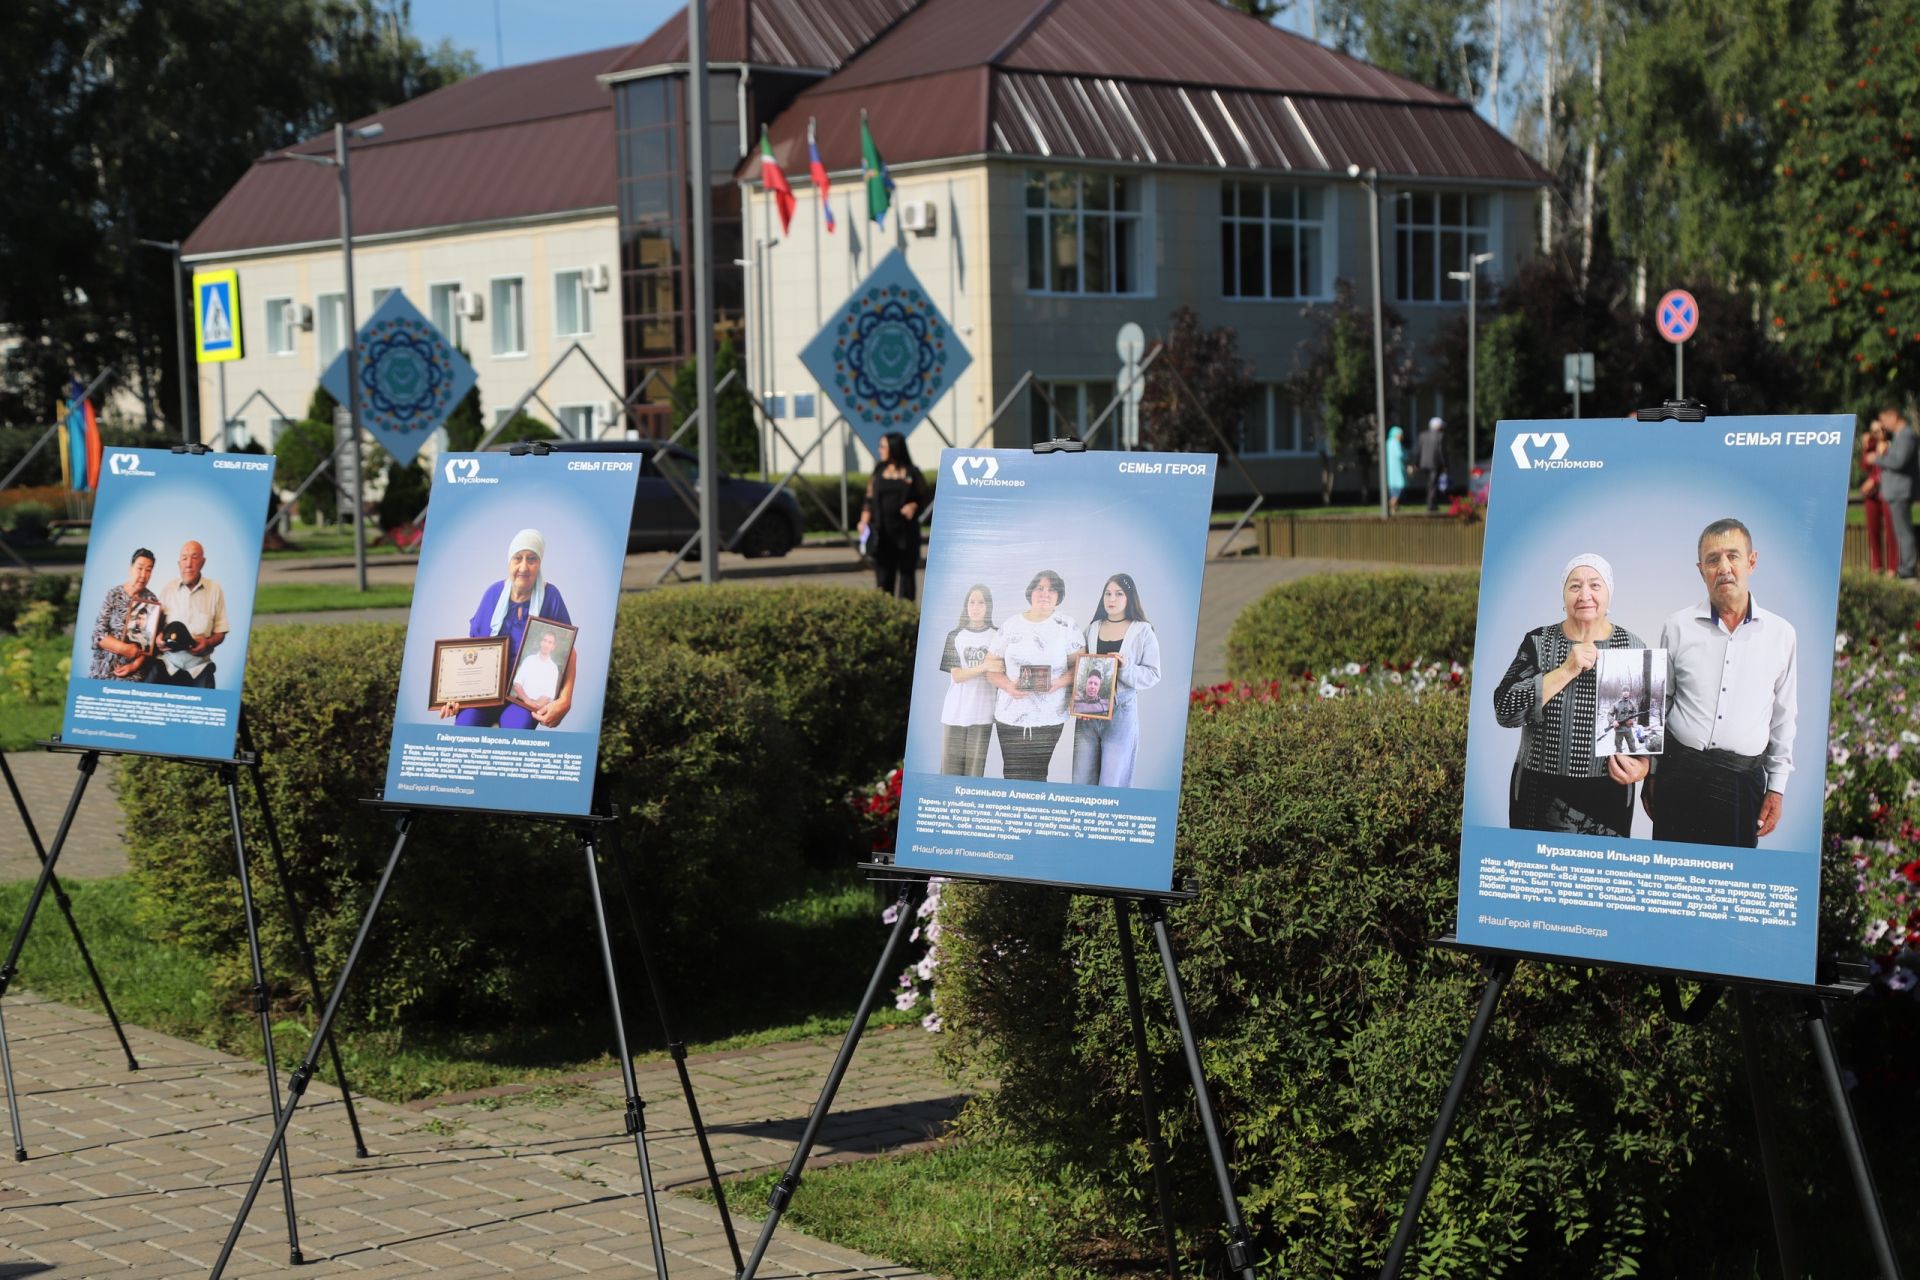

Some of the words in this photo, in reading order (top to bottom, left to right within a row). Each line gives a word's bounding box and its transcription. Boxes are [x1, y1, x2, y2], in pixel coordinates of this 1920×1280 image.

[1724, 432, 1781, 446] СЕМЬЯ
[1786, 431, 1841, 445] ГЕРОЯ
[213, 460, 241, 470] СЕМЬЯ
[242, 461, 268, 471] ГЕРОЯ
[568, 461, 600, 471] СЕМЬЯ
[602, 462, 633, 472] ГЕРОЯ
[1119, 462, 1162, 474] СЕМЬЯ
[1165, 463, 1206, 475] ГЕРОЯ
[1534, 458, 1604, 471] Муслюмово
[457, 476, 499, 485] Муслюмово
[970, 477, 1025, 488] Муслюмово
[481, 736, 511, 745] Марсель
[511, 738, 550, 747] Алмазович
[955, 786, 1007, 798] Красиньков
[1009, 790, 1046, 801] Алексей
[1048, 793, 1119, 806] Александрович
[912, 845, 954, 856] #НашГерой
[955, 849, 1014, 861] #ПомнимВсегда
[1537, 844, 1604, 859] Мурзаханов
[1607, 850, 1650, 866] Ильнар
[1653, 854, 1734, 871] Мирзаянович
[1480, 866, 1507, 876] любие,
[1521, 870, 1556, 880] говорил:
[1558, 873, 1578, 881] «Всё
[1580, 875, 1611, 884] сделаю
[1613, 878, 1637, 886] сам».
[1638, 879, 1663, 889] Часто
[1664, 883, 1713, 894] выбирался
[1727, 889, 1767, 900] природу,
[1769, 893, 1798, 901] чтобы
[1481, 858, 1501, 866] «Наш
[1503, 860, 1549, 870] «Мурзахан»
[1551, 864, 1568, 872] был
[1570, 867, 1595, 875] тихим
[1605, 870, 1652, 880] спокойным
[1654, 874, 1687, 883] парнем.
[1690, 876, 1706, 884] Все
[1708, 879, 1750, 888] отмечали
[1752, 882, 1767, 890] его
[1769, 884, 1798, 893] трудо-
[1479, 881, 1506, 890] Любил
[1510, 885, 1553, 895] проводить
[1558, 889, 1584, 898] время
[1598, 892, 1636, 903] большой
[1641, 897, 1683, 907] компании
[1687, 902, 1718, 911] друзей
[1734, 905, 1772, 916] близких.
[1480, 874, 1529, 885] порыбачить.
[1531, 878, 1549, 886] Был
[1551, 881, 1573, 889] готов
[1575, 883, 1604, 892] многое
[1605, 886, 1634, 894] отдать
[1647, 890, 1670, 898] свою
[1672, 892, 1703, 902] семью,
[1705, 894, 1738, 904] обожал
[1740, 898, 1767, 907] своих
[1769, 901, 1796, 909] детей.
[1479, 890, 1521, 900] последний
[1523, 894, 1541, 902] путь
[1559, 898, 1604, 908] провожали
[1606, 902, 1646, 912] огромное
[1648, 906, 1697, 917] количество
[1699, 911, 1728, 920] людей
[1738, 915, 1760, 923] весь
[1762, 917, 1796, 927] район.»
[1479, 915, 1530, 929] #НашГерой
[1532, 921, 1608, 938] #ПомнимВсегда
